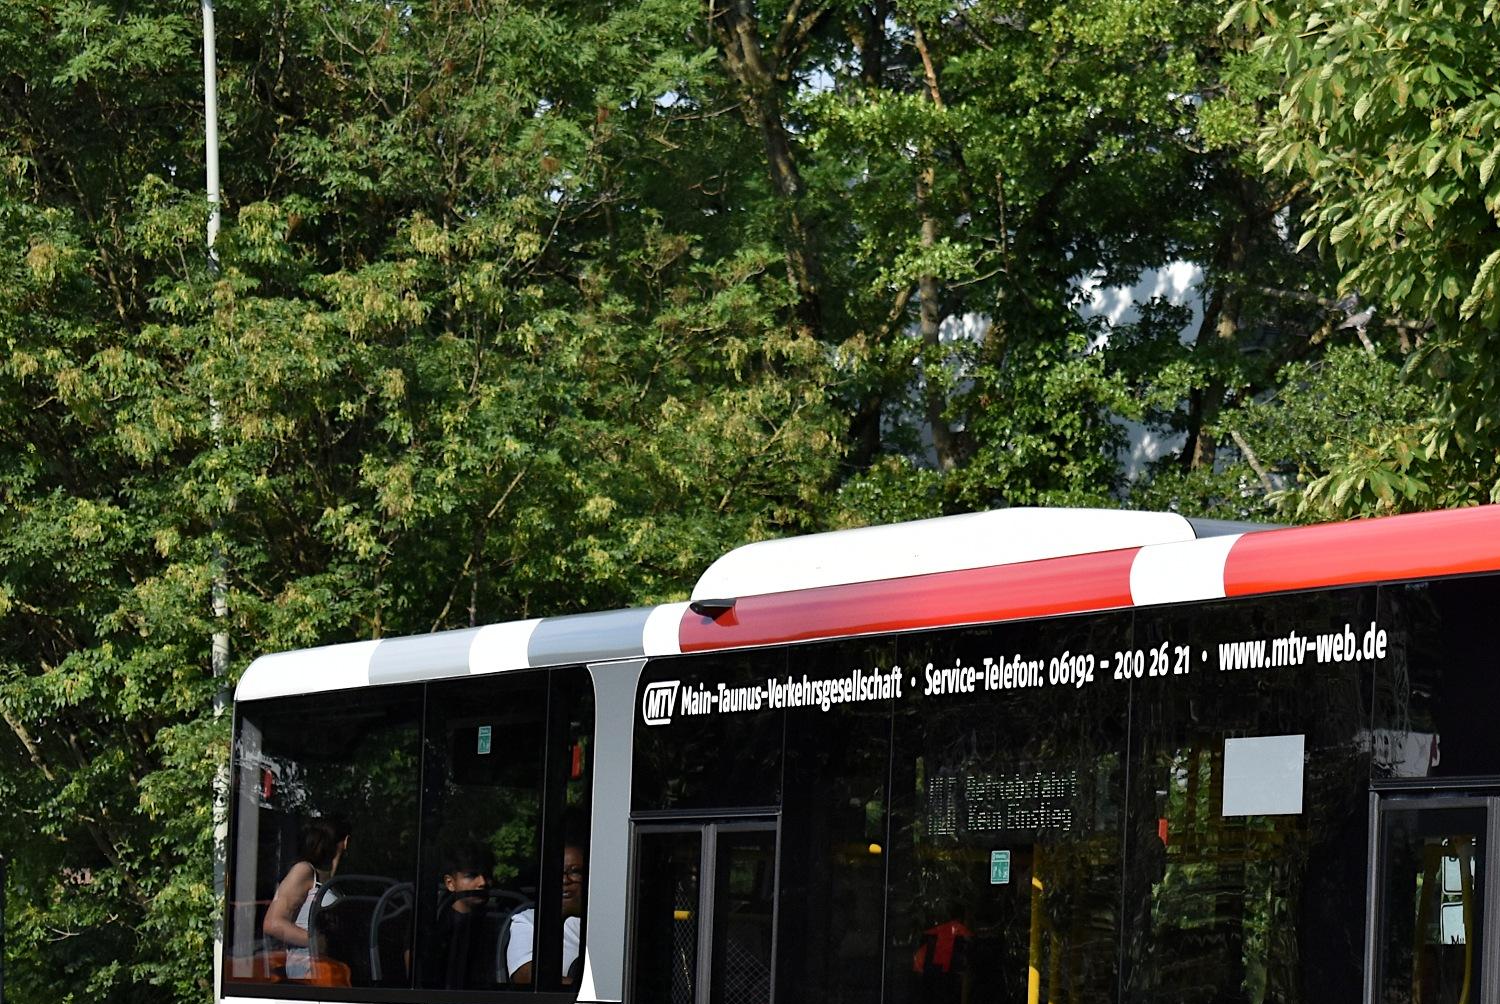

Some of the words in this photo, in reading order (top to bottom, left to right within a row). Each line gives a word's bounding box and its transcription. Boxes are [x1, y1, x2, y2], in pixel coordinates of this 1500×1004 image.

[646, 682, 679, 721] MTV
[681, 666, 902, 716] Main-Taunus-Verkehrsgesellschaft
[925, 654, 1044, 696] Service-Telefon:
[1049, 653, 1094, 689] 06192
[1114, 651, 1145, 680] 200
[1149, 642, 1169, 677] 26
[1174, 645, 1190, 674] 21
[1219, 622, 1387, 671] www.mtv-web.de
